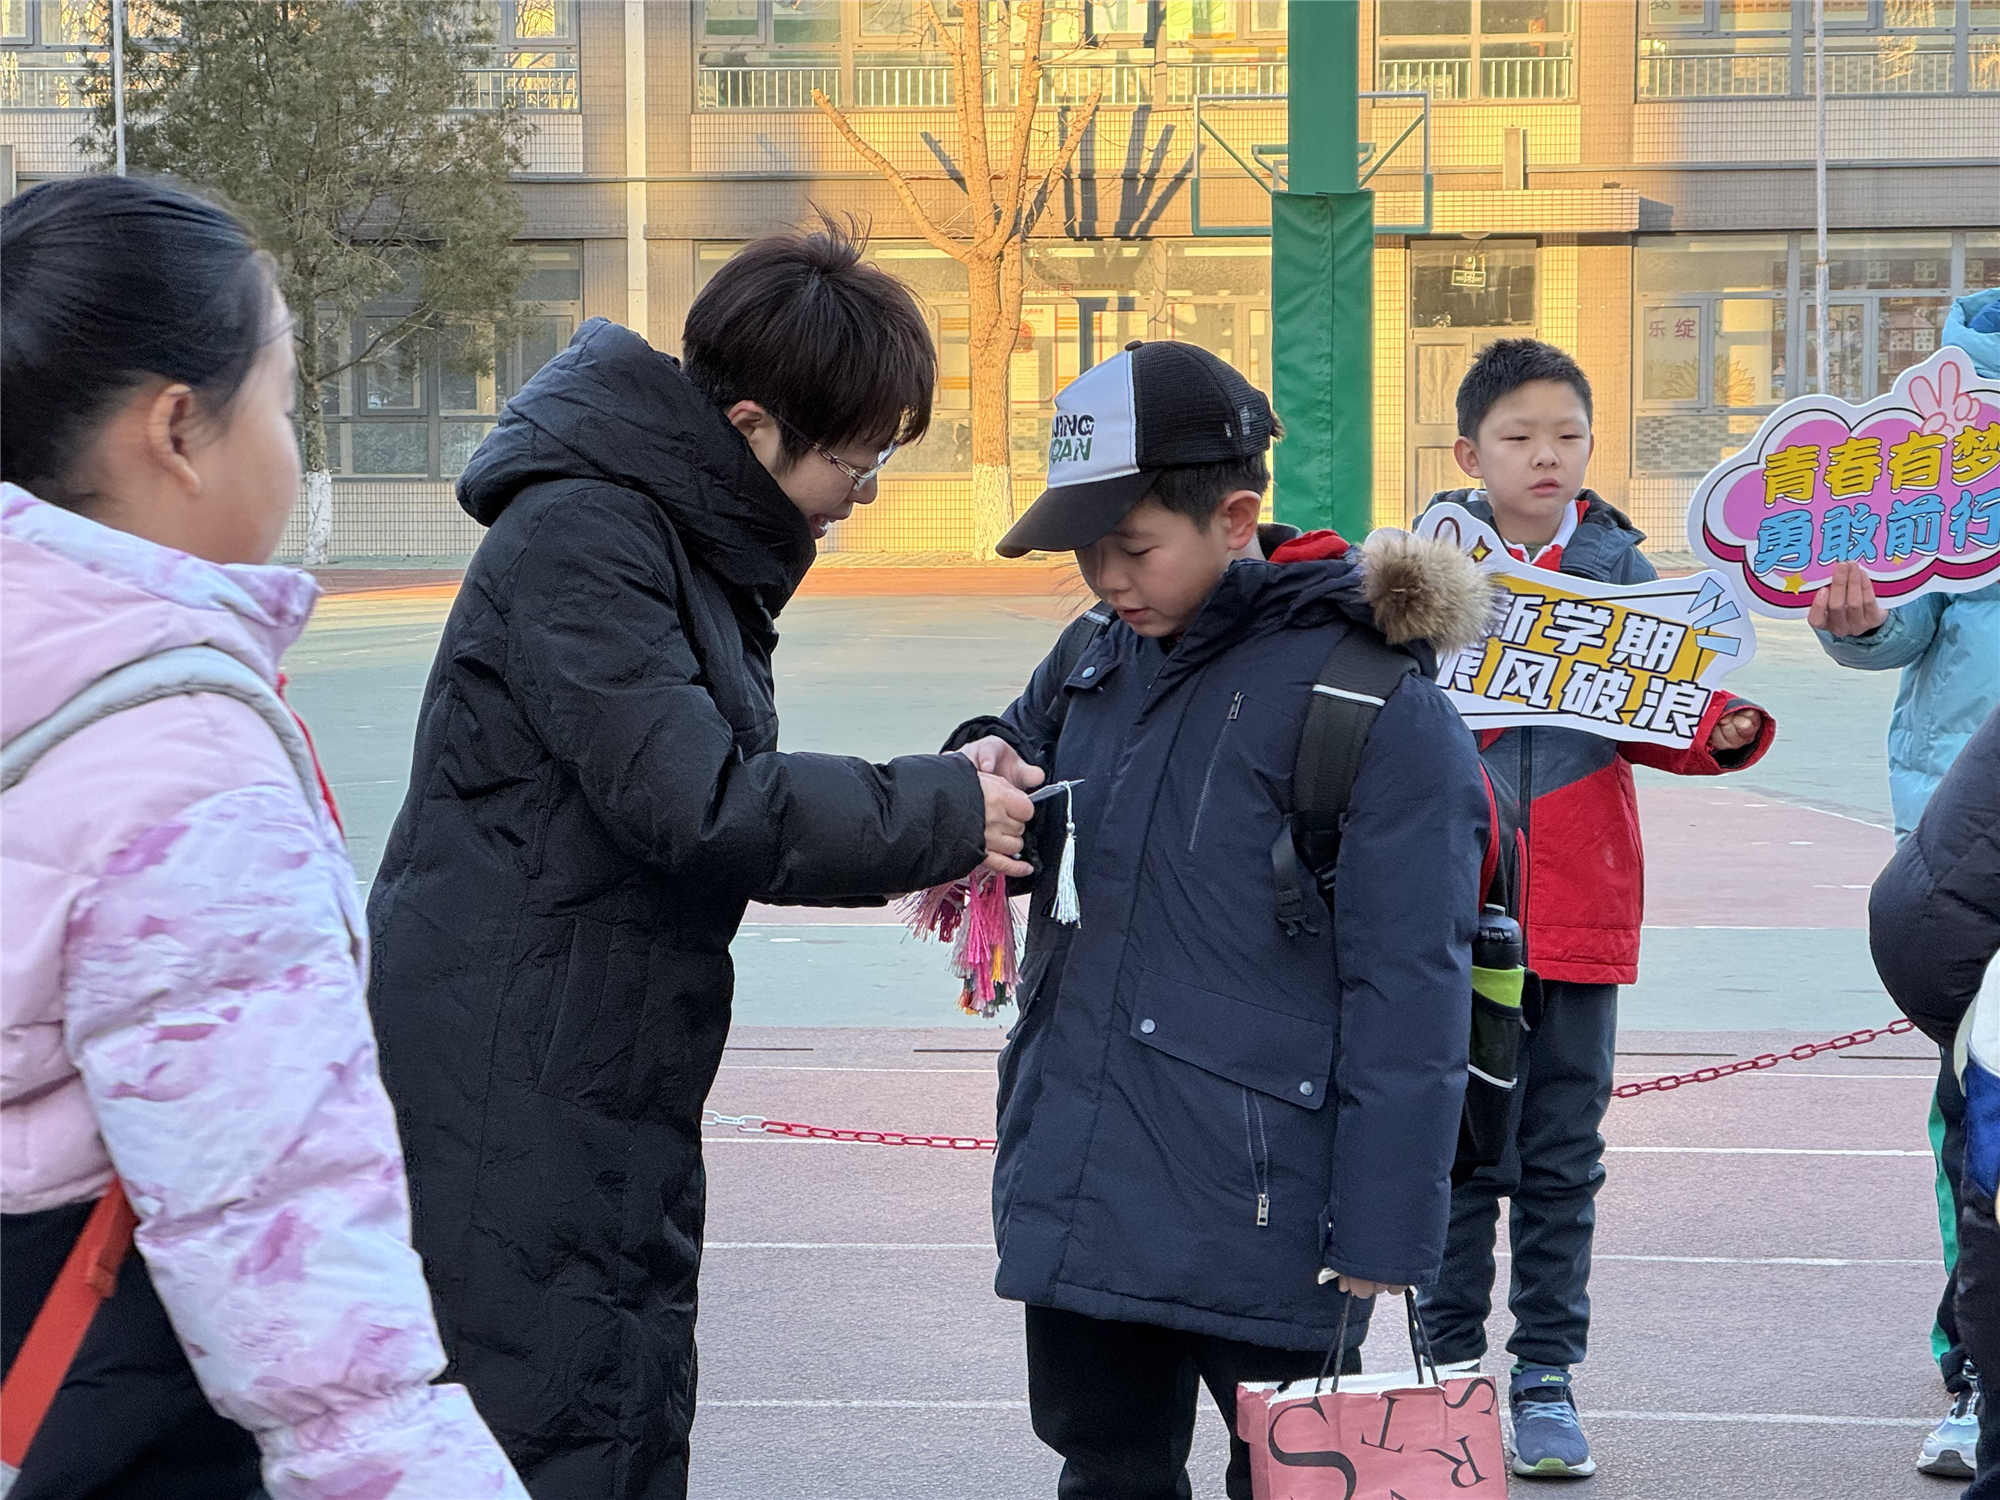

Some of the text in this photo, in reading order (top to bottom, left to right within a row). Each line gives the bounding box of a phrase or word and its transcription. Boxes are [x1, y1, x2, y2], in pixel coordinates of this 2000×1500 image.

[1763, 422, 2000, 508] 青春有梦
[1754, 488, 2000, 576] 勇敢前行
